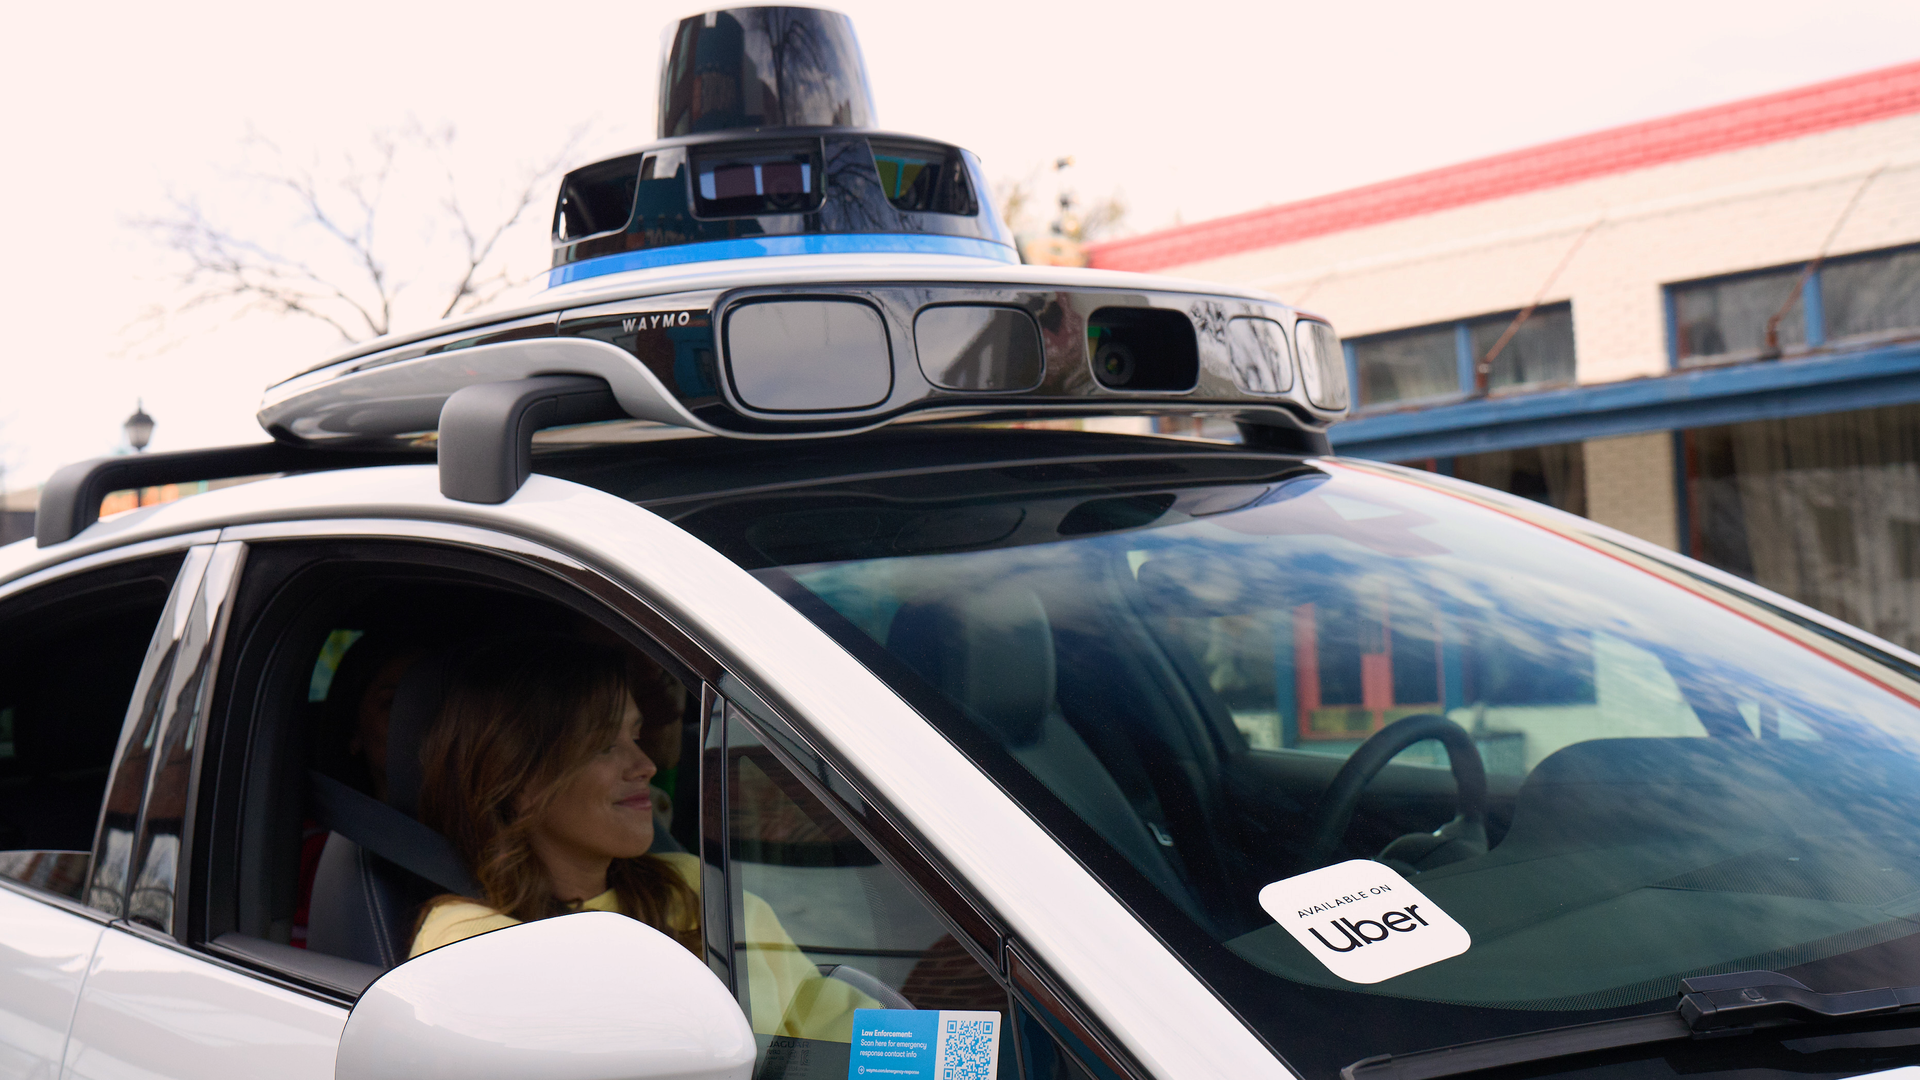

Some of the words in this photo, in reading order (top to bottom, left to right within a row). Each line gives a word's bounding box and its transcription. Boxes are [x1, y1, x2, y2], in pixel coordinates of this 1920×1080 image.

[622, 311, 690, 333] WAYMO
[1297, 890, 1369, 919] AVAILABLE
[1370, 884, 1392, 896] ON
[1308, 904, 1430, 953] Uber
[861, 1029, 873, 1037] Law
[874, 1029, 913, 1038] Enforcement:
[767, 1040, 810, 1049] JAGUAR
[860, 1038, 874, 1047] Scan
[875, 1039, 887, 1047] here
[888, 1039, 896, 1047] for
[896, 1042, 928, 1050] emergency
[859, 1050, 883, 1058] response
[906, 1050, 918, 1058] info
